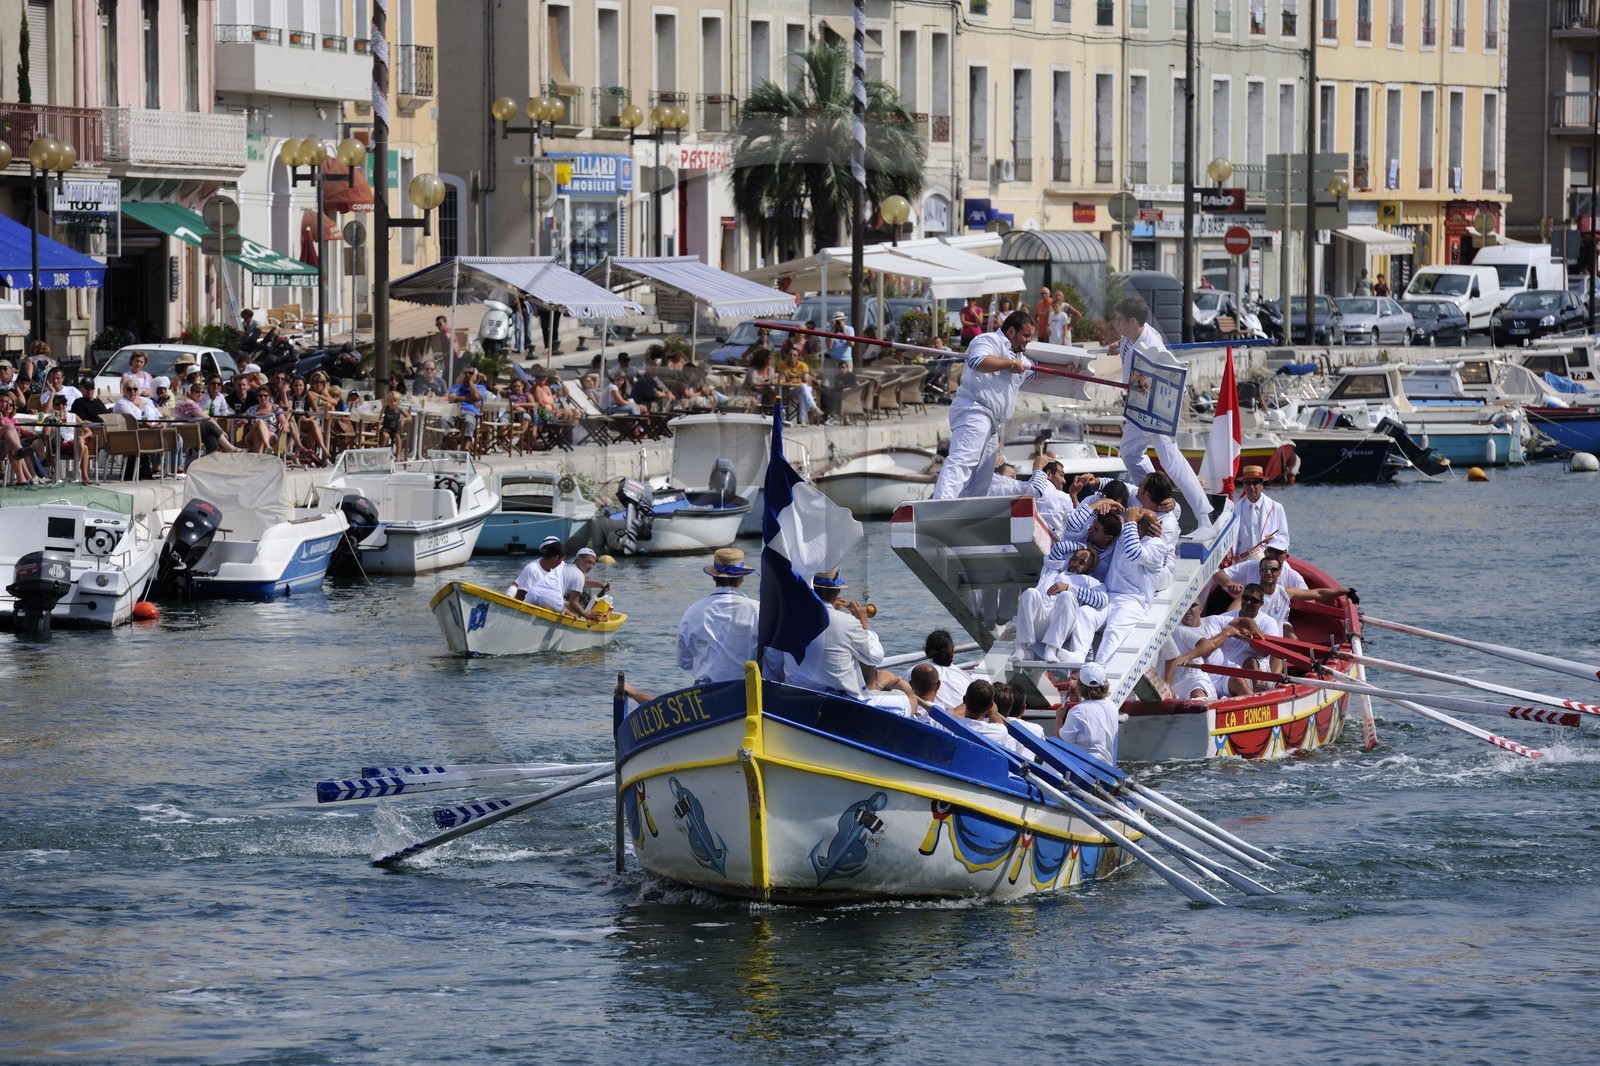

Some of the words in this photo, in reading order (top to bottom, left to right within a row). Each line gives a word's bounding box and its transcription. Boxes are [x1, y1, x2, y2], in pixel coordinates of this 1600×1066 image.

[967, 211, 987, 221] AXA
[630, 709, 654, 740] VILLE
[651, 702, 670, 730] DE
[667, 689, 711, 725] SETE
[1225, 711, 1237, 728] LA
[1243, 705, 1271, 725] PONCHA
